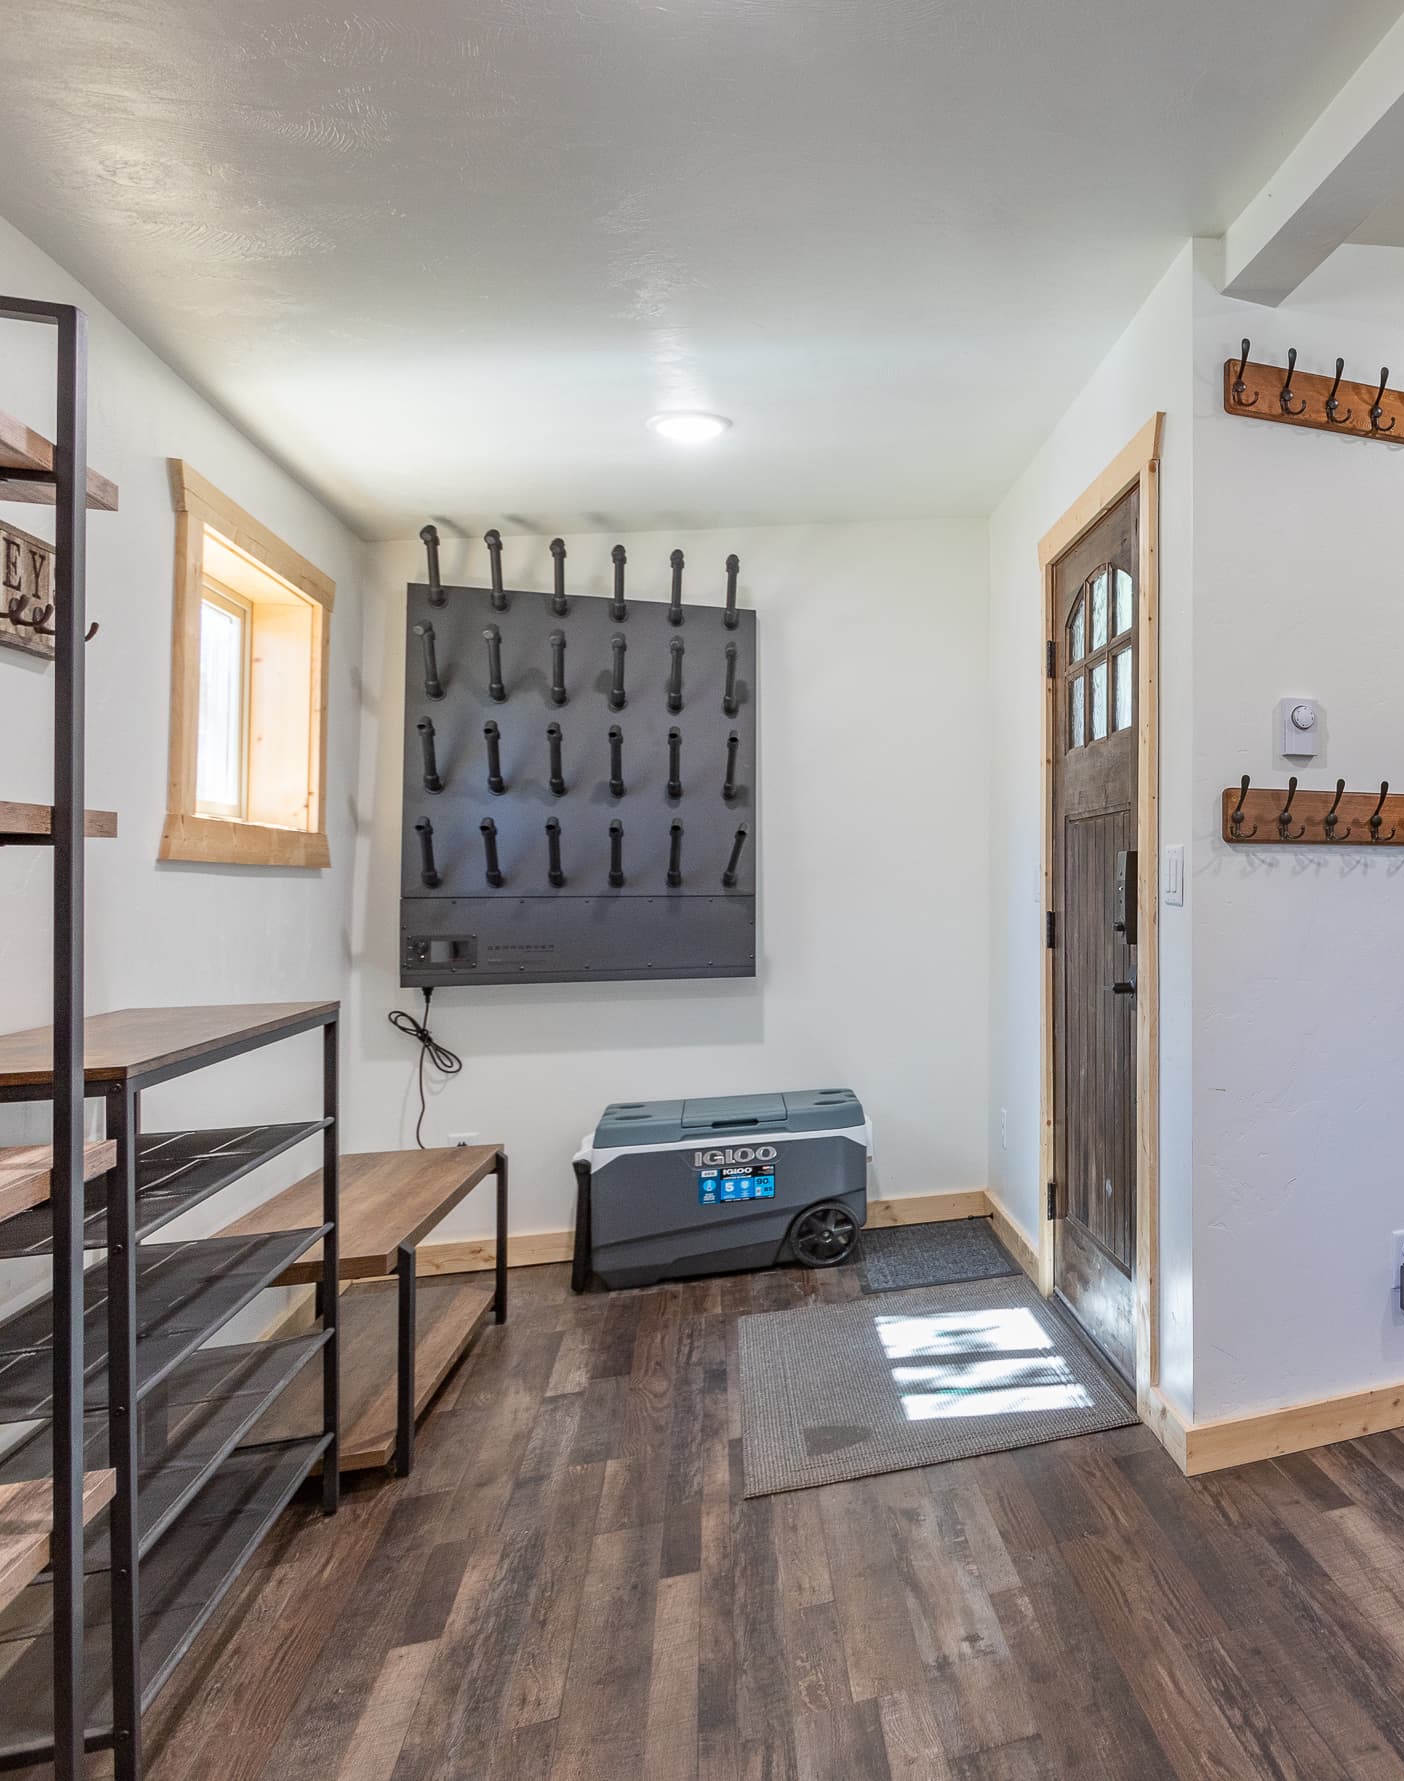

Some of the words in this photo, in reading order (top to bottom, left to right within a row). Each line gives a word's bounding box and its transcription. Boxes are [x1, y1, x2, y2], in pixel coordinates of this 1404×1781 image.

[3, 537, 49, 599] EY
[694, 1146, 777, 1166] IGLOO
[723, 1167, 752, 1175] IGLOO
